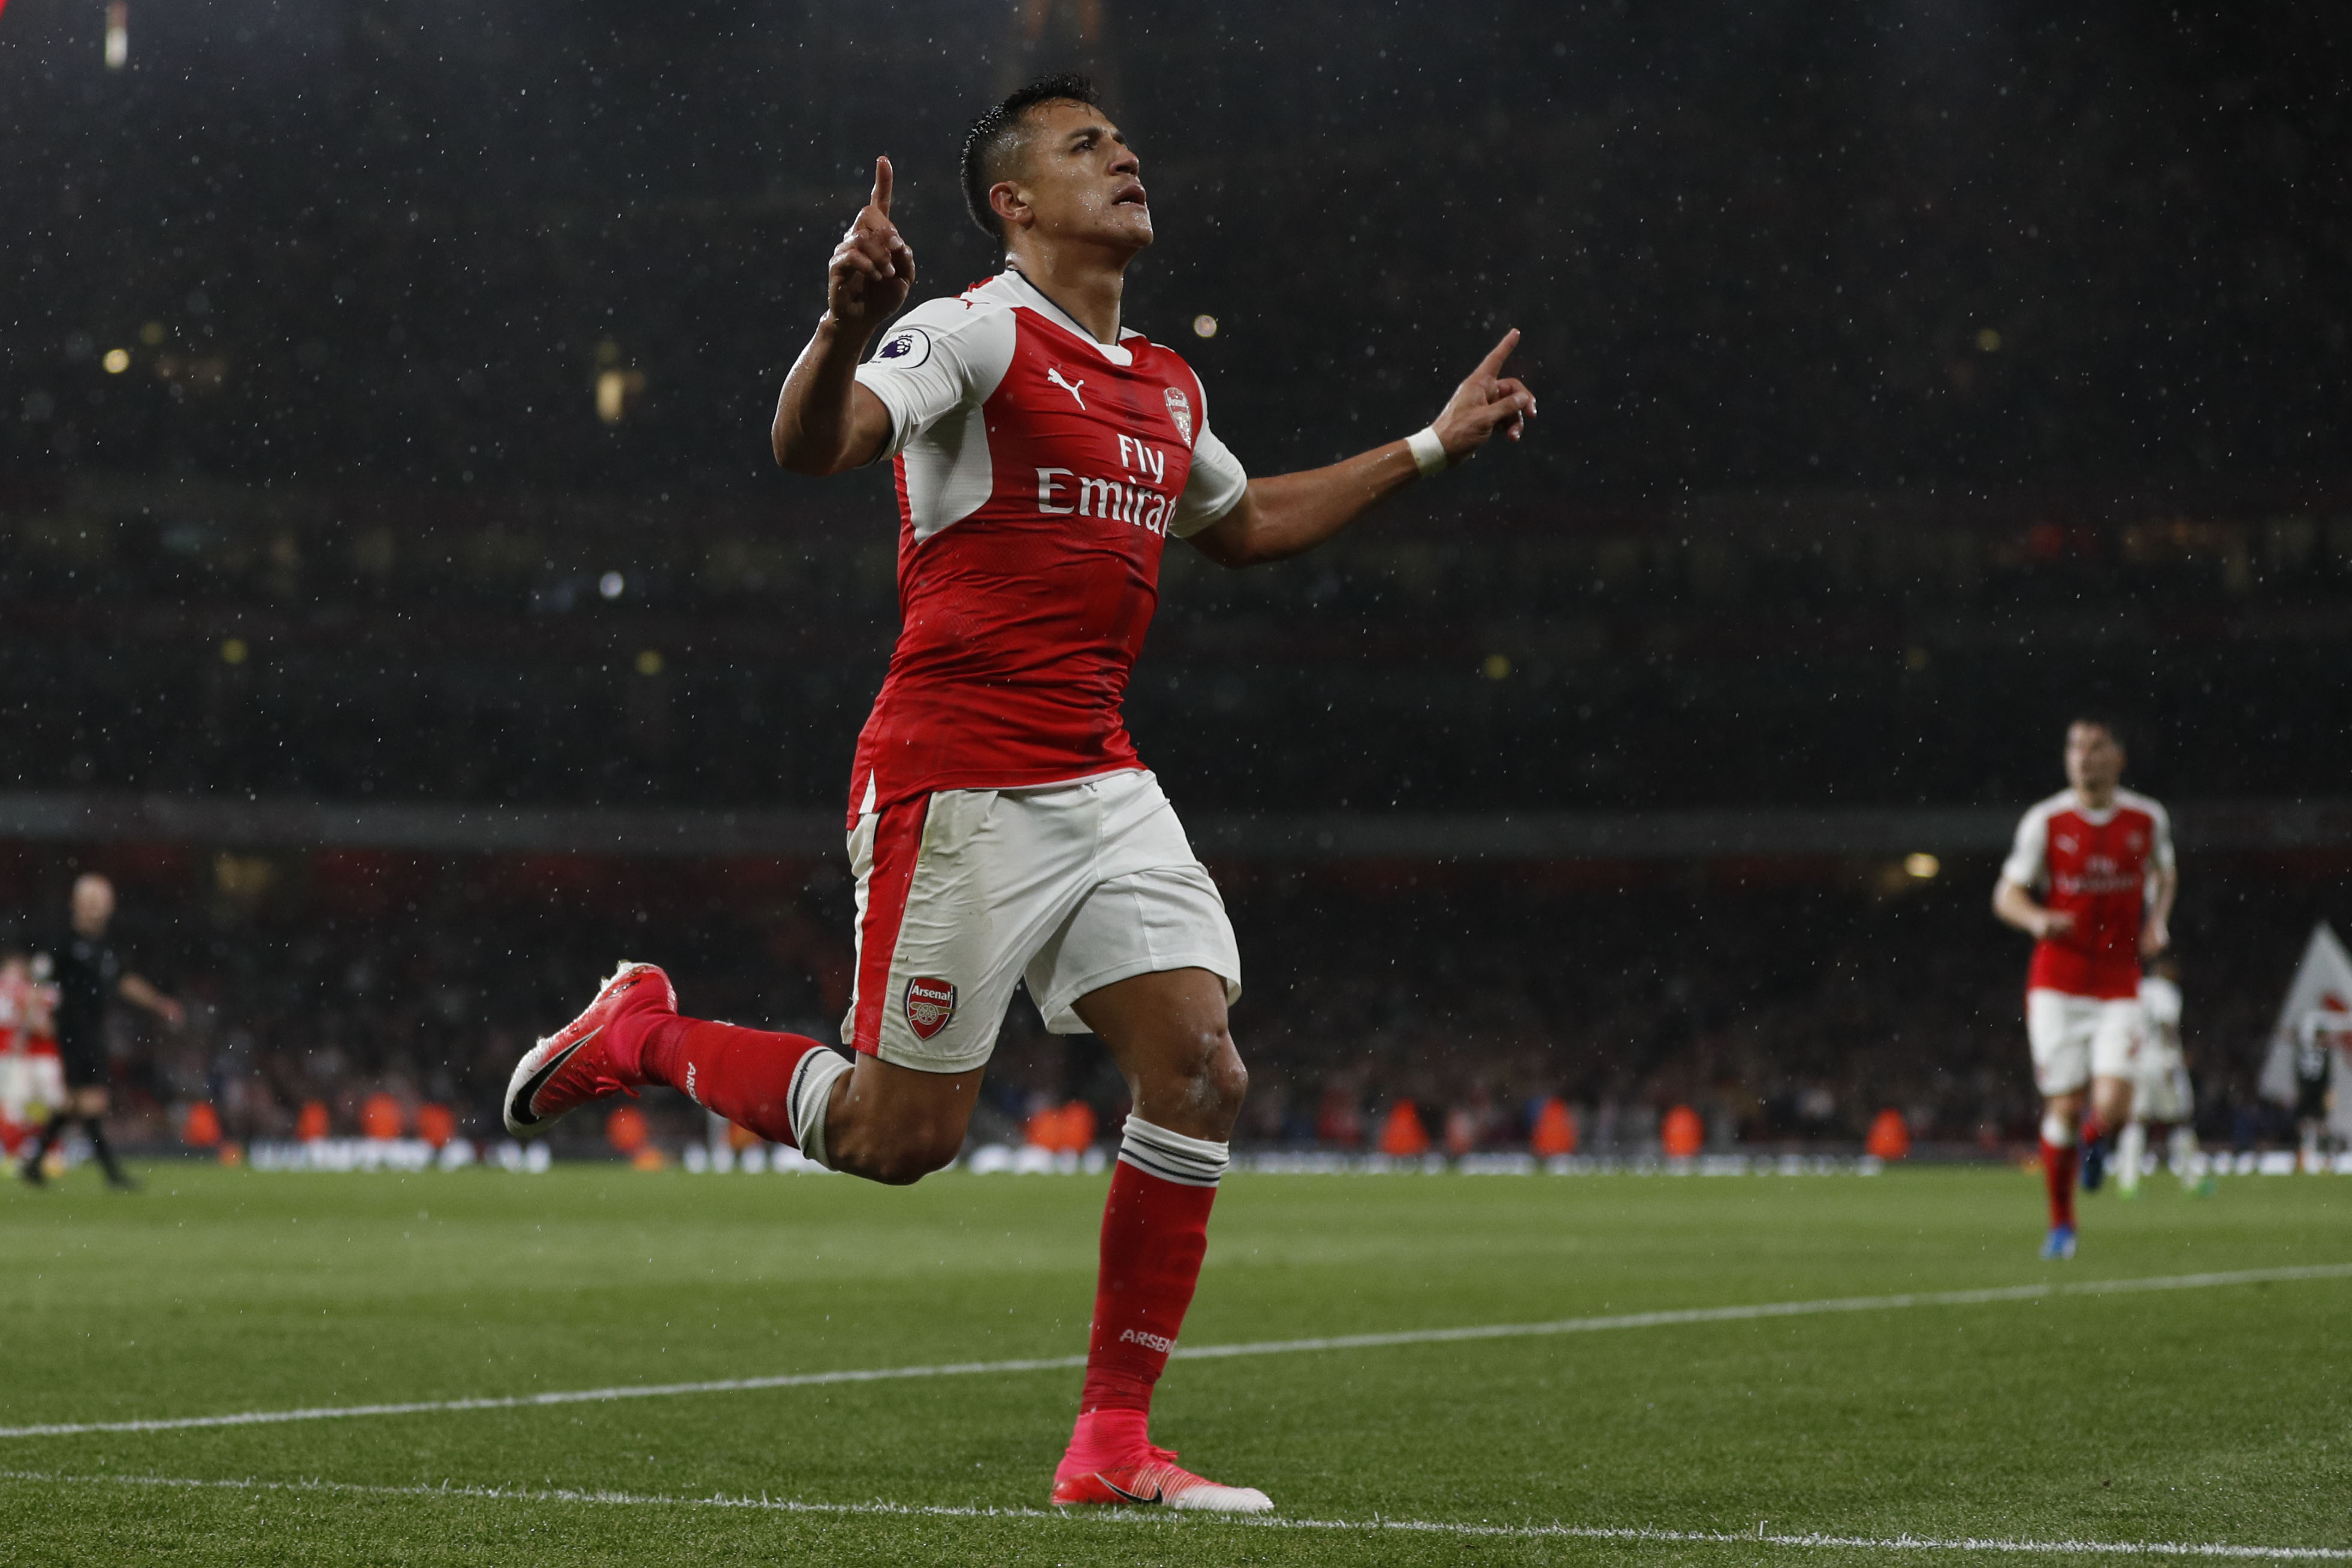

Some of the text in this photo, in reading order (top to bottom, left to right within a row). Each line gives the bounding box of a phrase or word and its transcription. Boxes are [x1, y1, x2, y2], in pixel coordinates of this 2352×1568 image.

[1117, 433, 1164, 484] Fly
[1035, 467, 1177, 538] Emirat
[911, 985, 950, 1001] Arsenal
